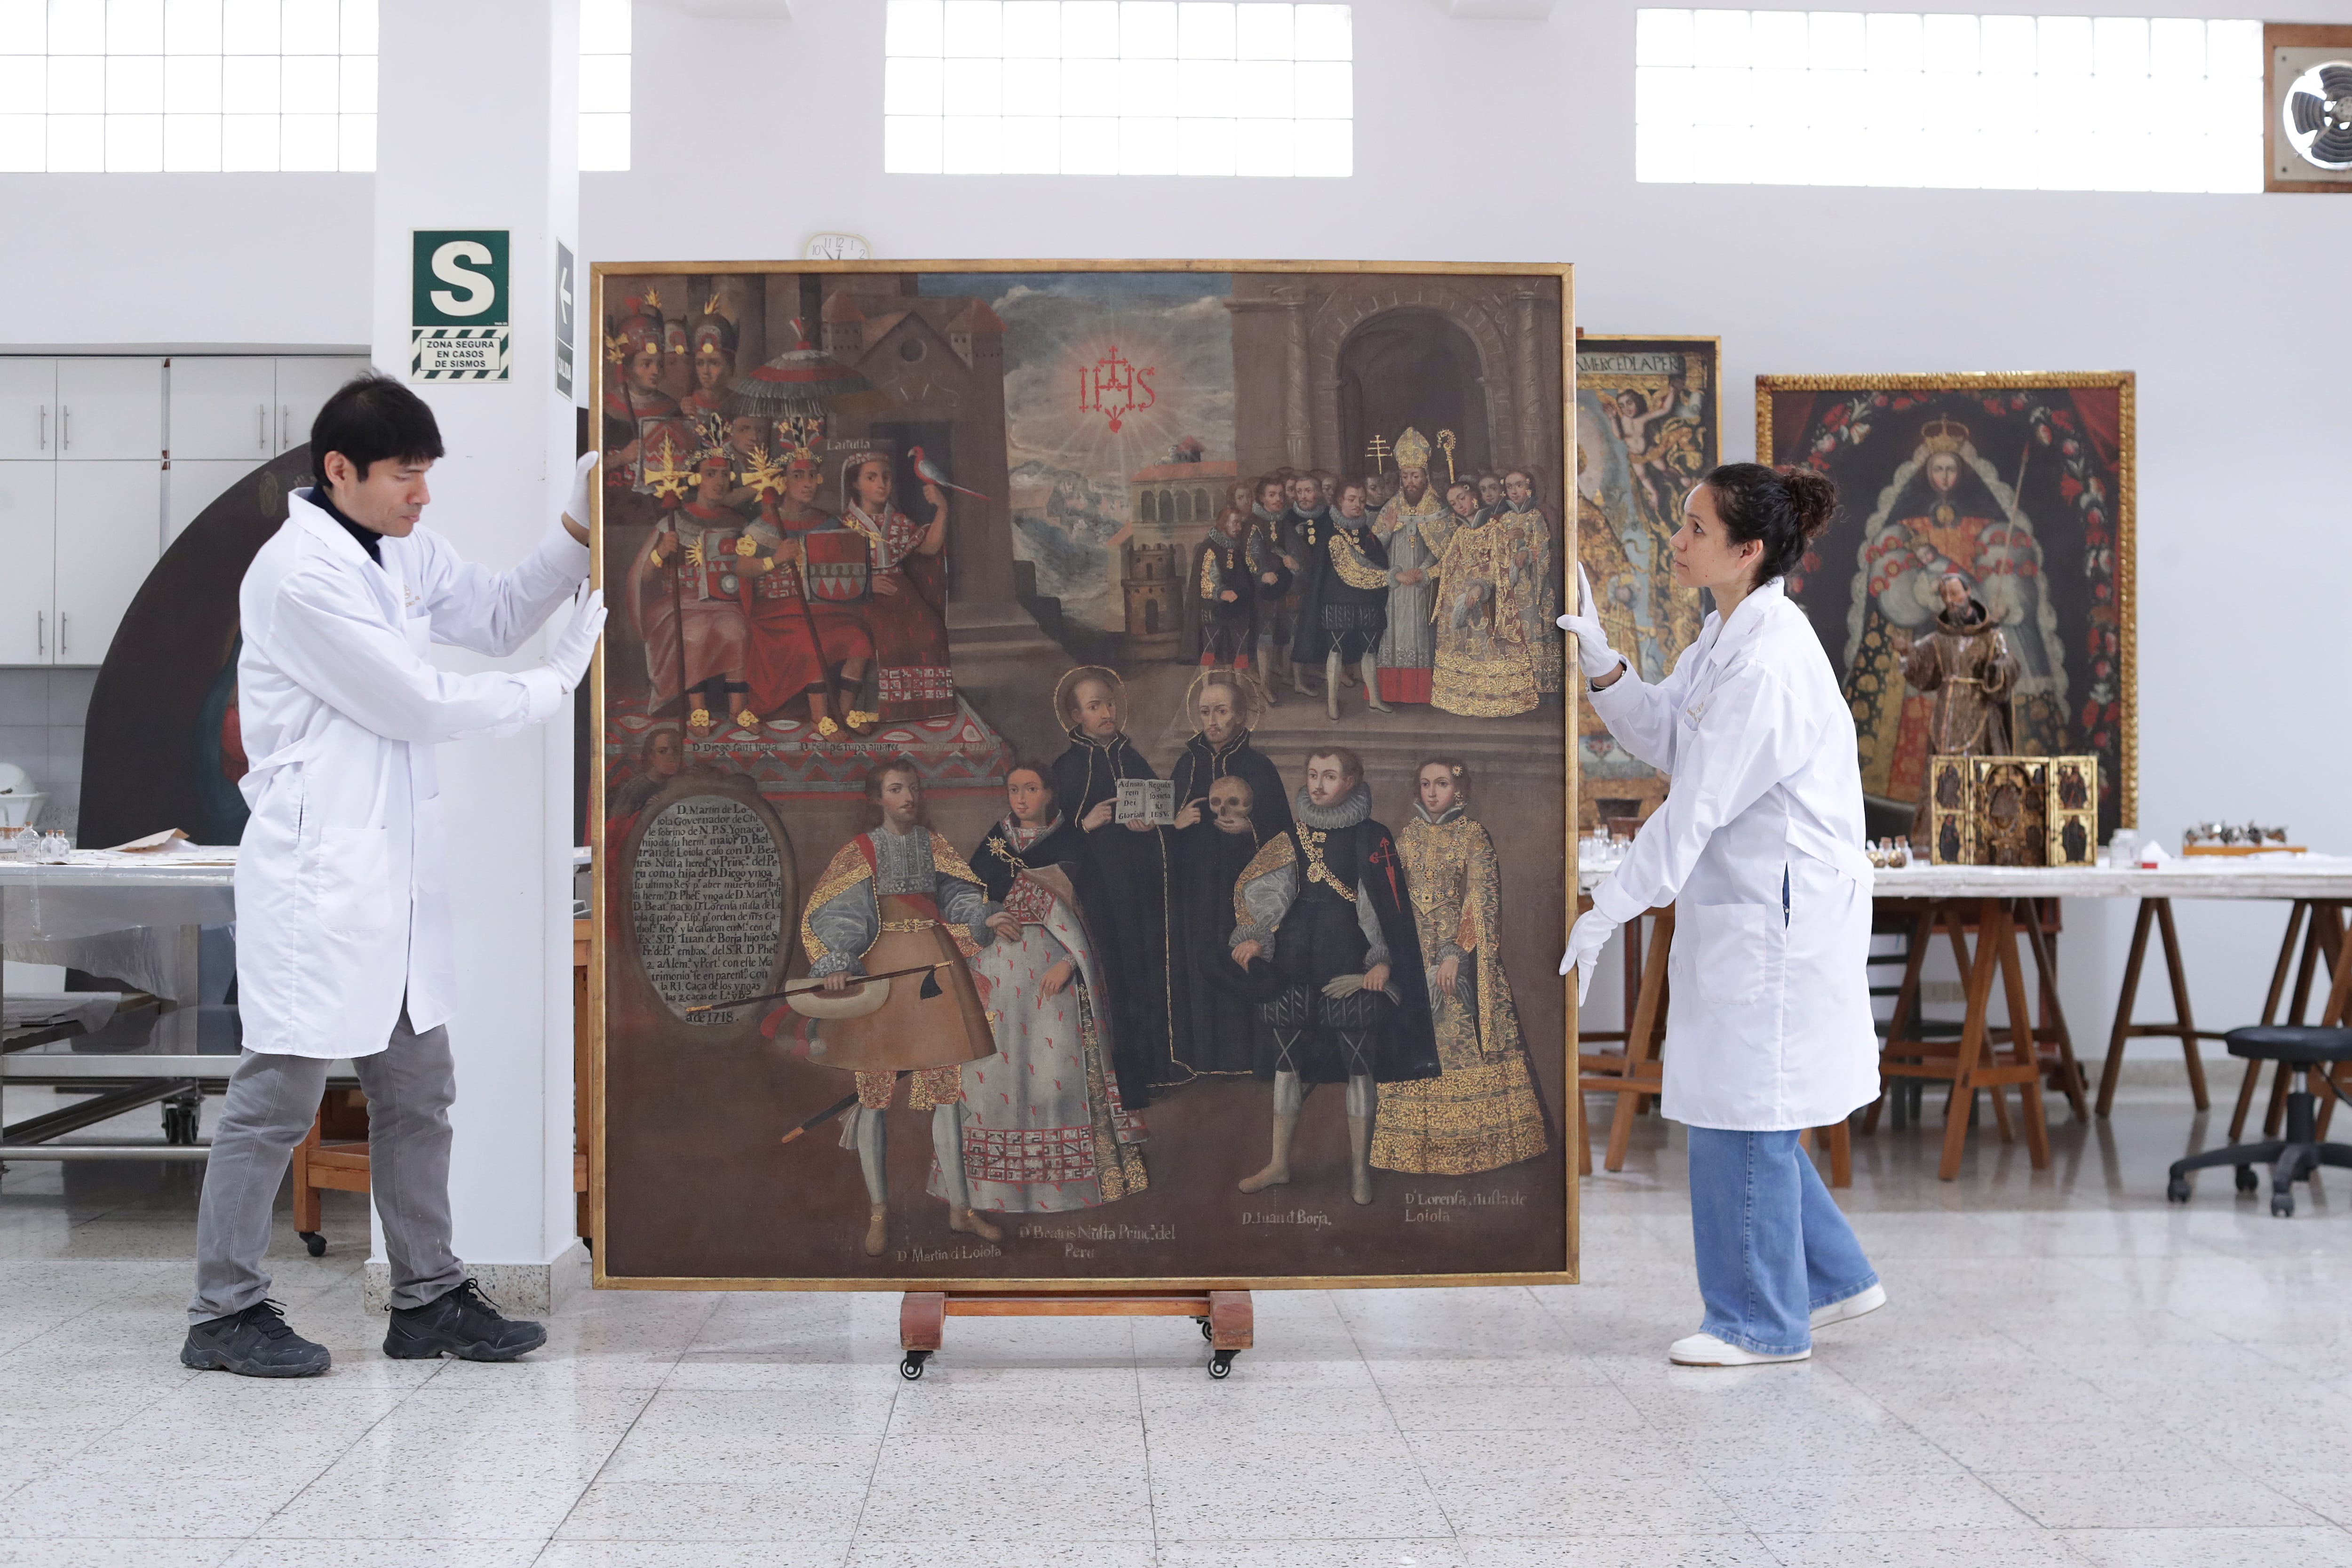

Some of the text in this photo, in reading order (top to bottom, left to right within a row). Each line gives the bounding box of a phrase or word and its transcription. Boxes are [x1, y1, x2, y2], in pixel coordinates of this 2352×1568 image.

[824, 238, 831, 248] 11
[836, 237, 844, 247] 12
[812, 245, 820, 255] 10
[859, 249, 865, 259] 2
[430, 241, 495, 316] S
[722, 804, 731, 813] de
[688, 826, 697, 835] de
[712, 912, 735, 921] orden
[720, 981, 731, 990] los
